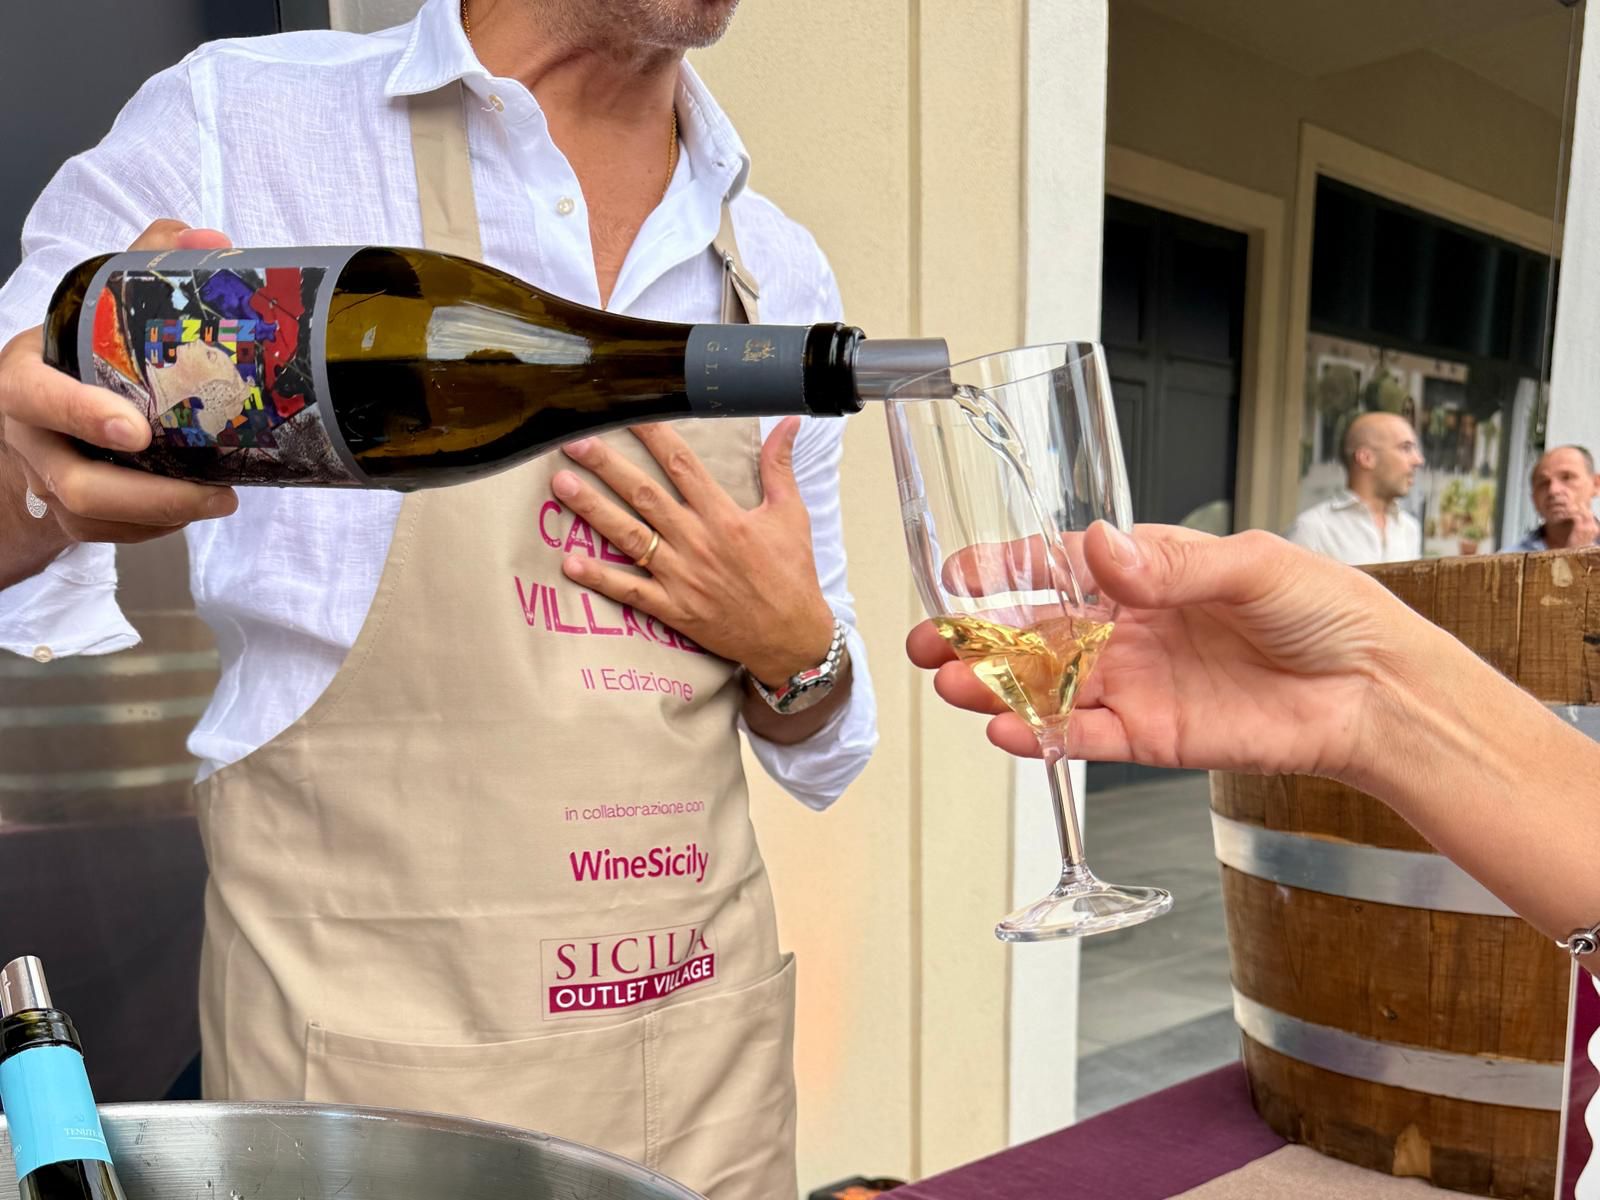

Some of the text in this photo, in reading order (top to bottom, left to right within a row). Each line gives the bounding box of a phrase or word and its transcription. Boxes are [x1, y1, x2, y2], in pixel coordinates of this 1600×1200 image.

[582, 669, 693, 702] II Edizione
[565, 800, 705, 821] in collaborazione con
[569, 843, 709, 884] WineSicily
[556, 928, 709, 980] SICILIA
[556, 958, 711, 1008] OUTLET VILLAGE
